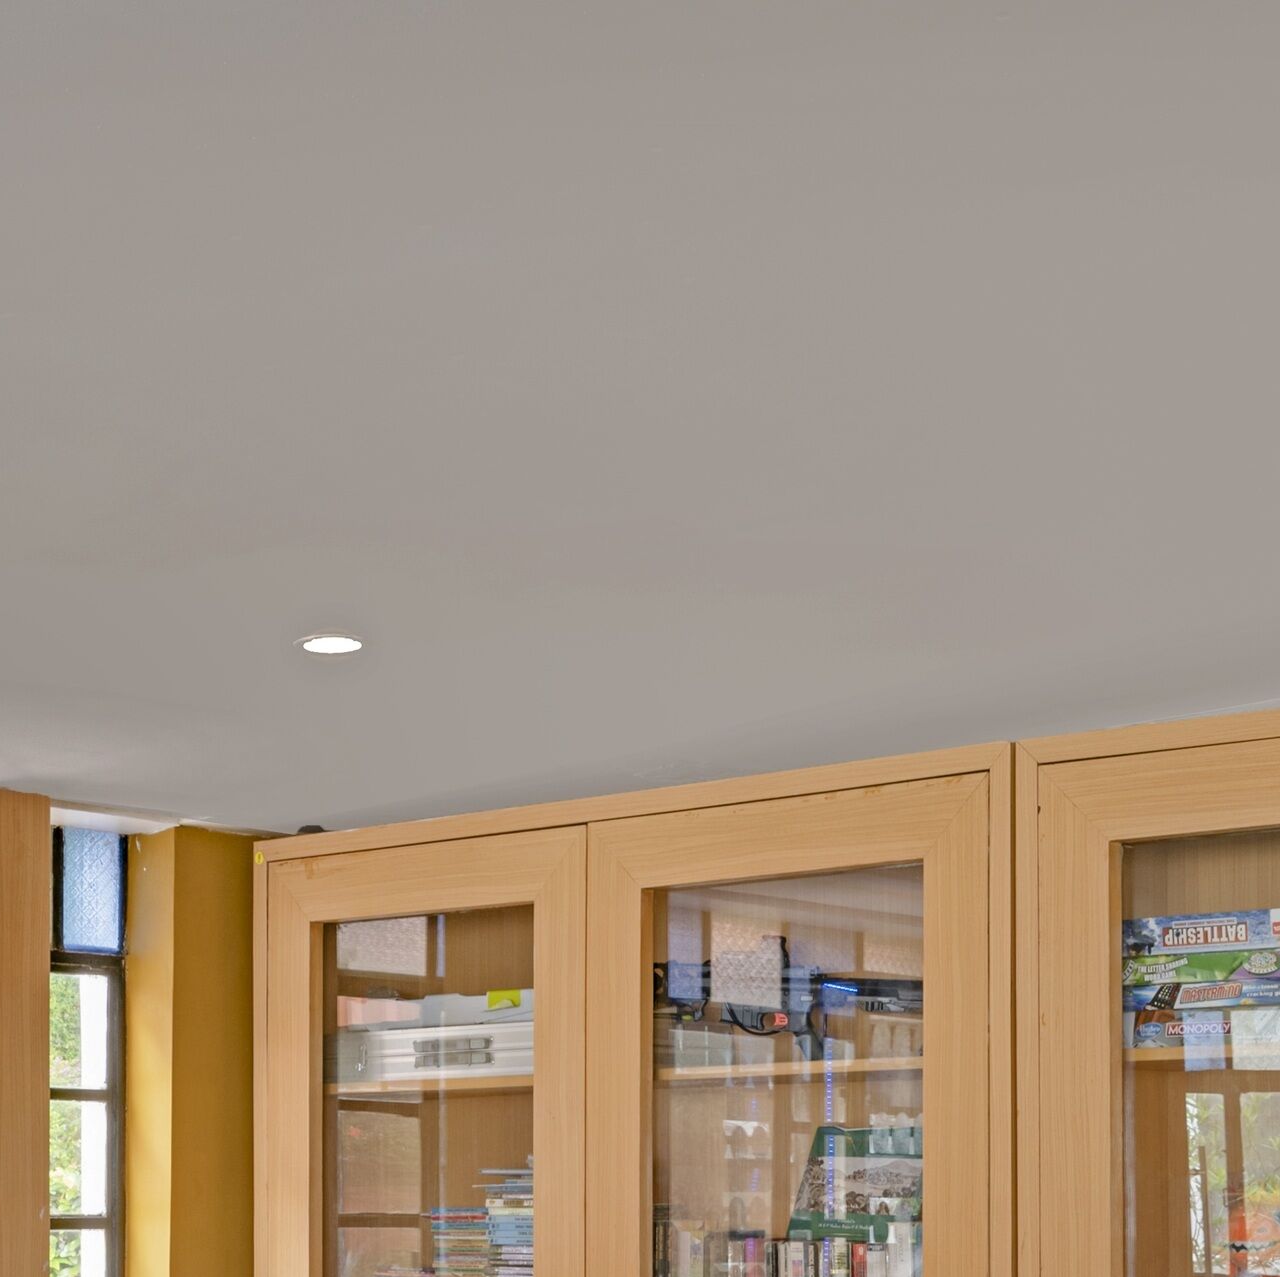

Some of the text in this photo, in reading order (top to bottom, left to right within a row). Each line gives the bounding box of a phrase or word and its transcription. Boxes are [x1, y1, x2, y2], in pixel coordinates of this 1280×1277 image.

[1165, 926, 1247, 945] BATTLESHIP
[1181, 984, 1242, 1003] MASTERMIND
[1167, 1023, 1230, 1035] MONOPOLY
